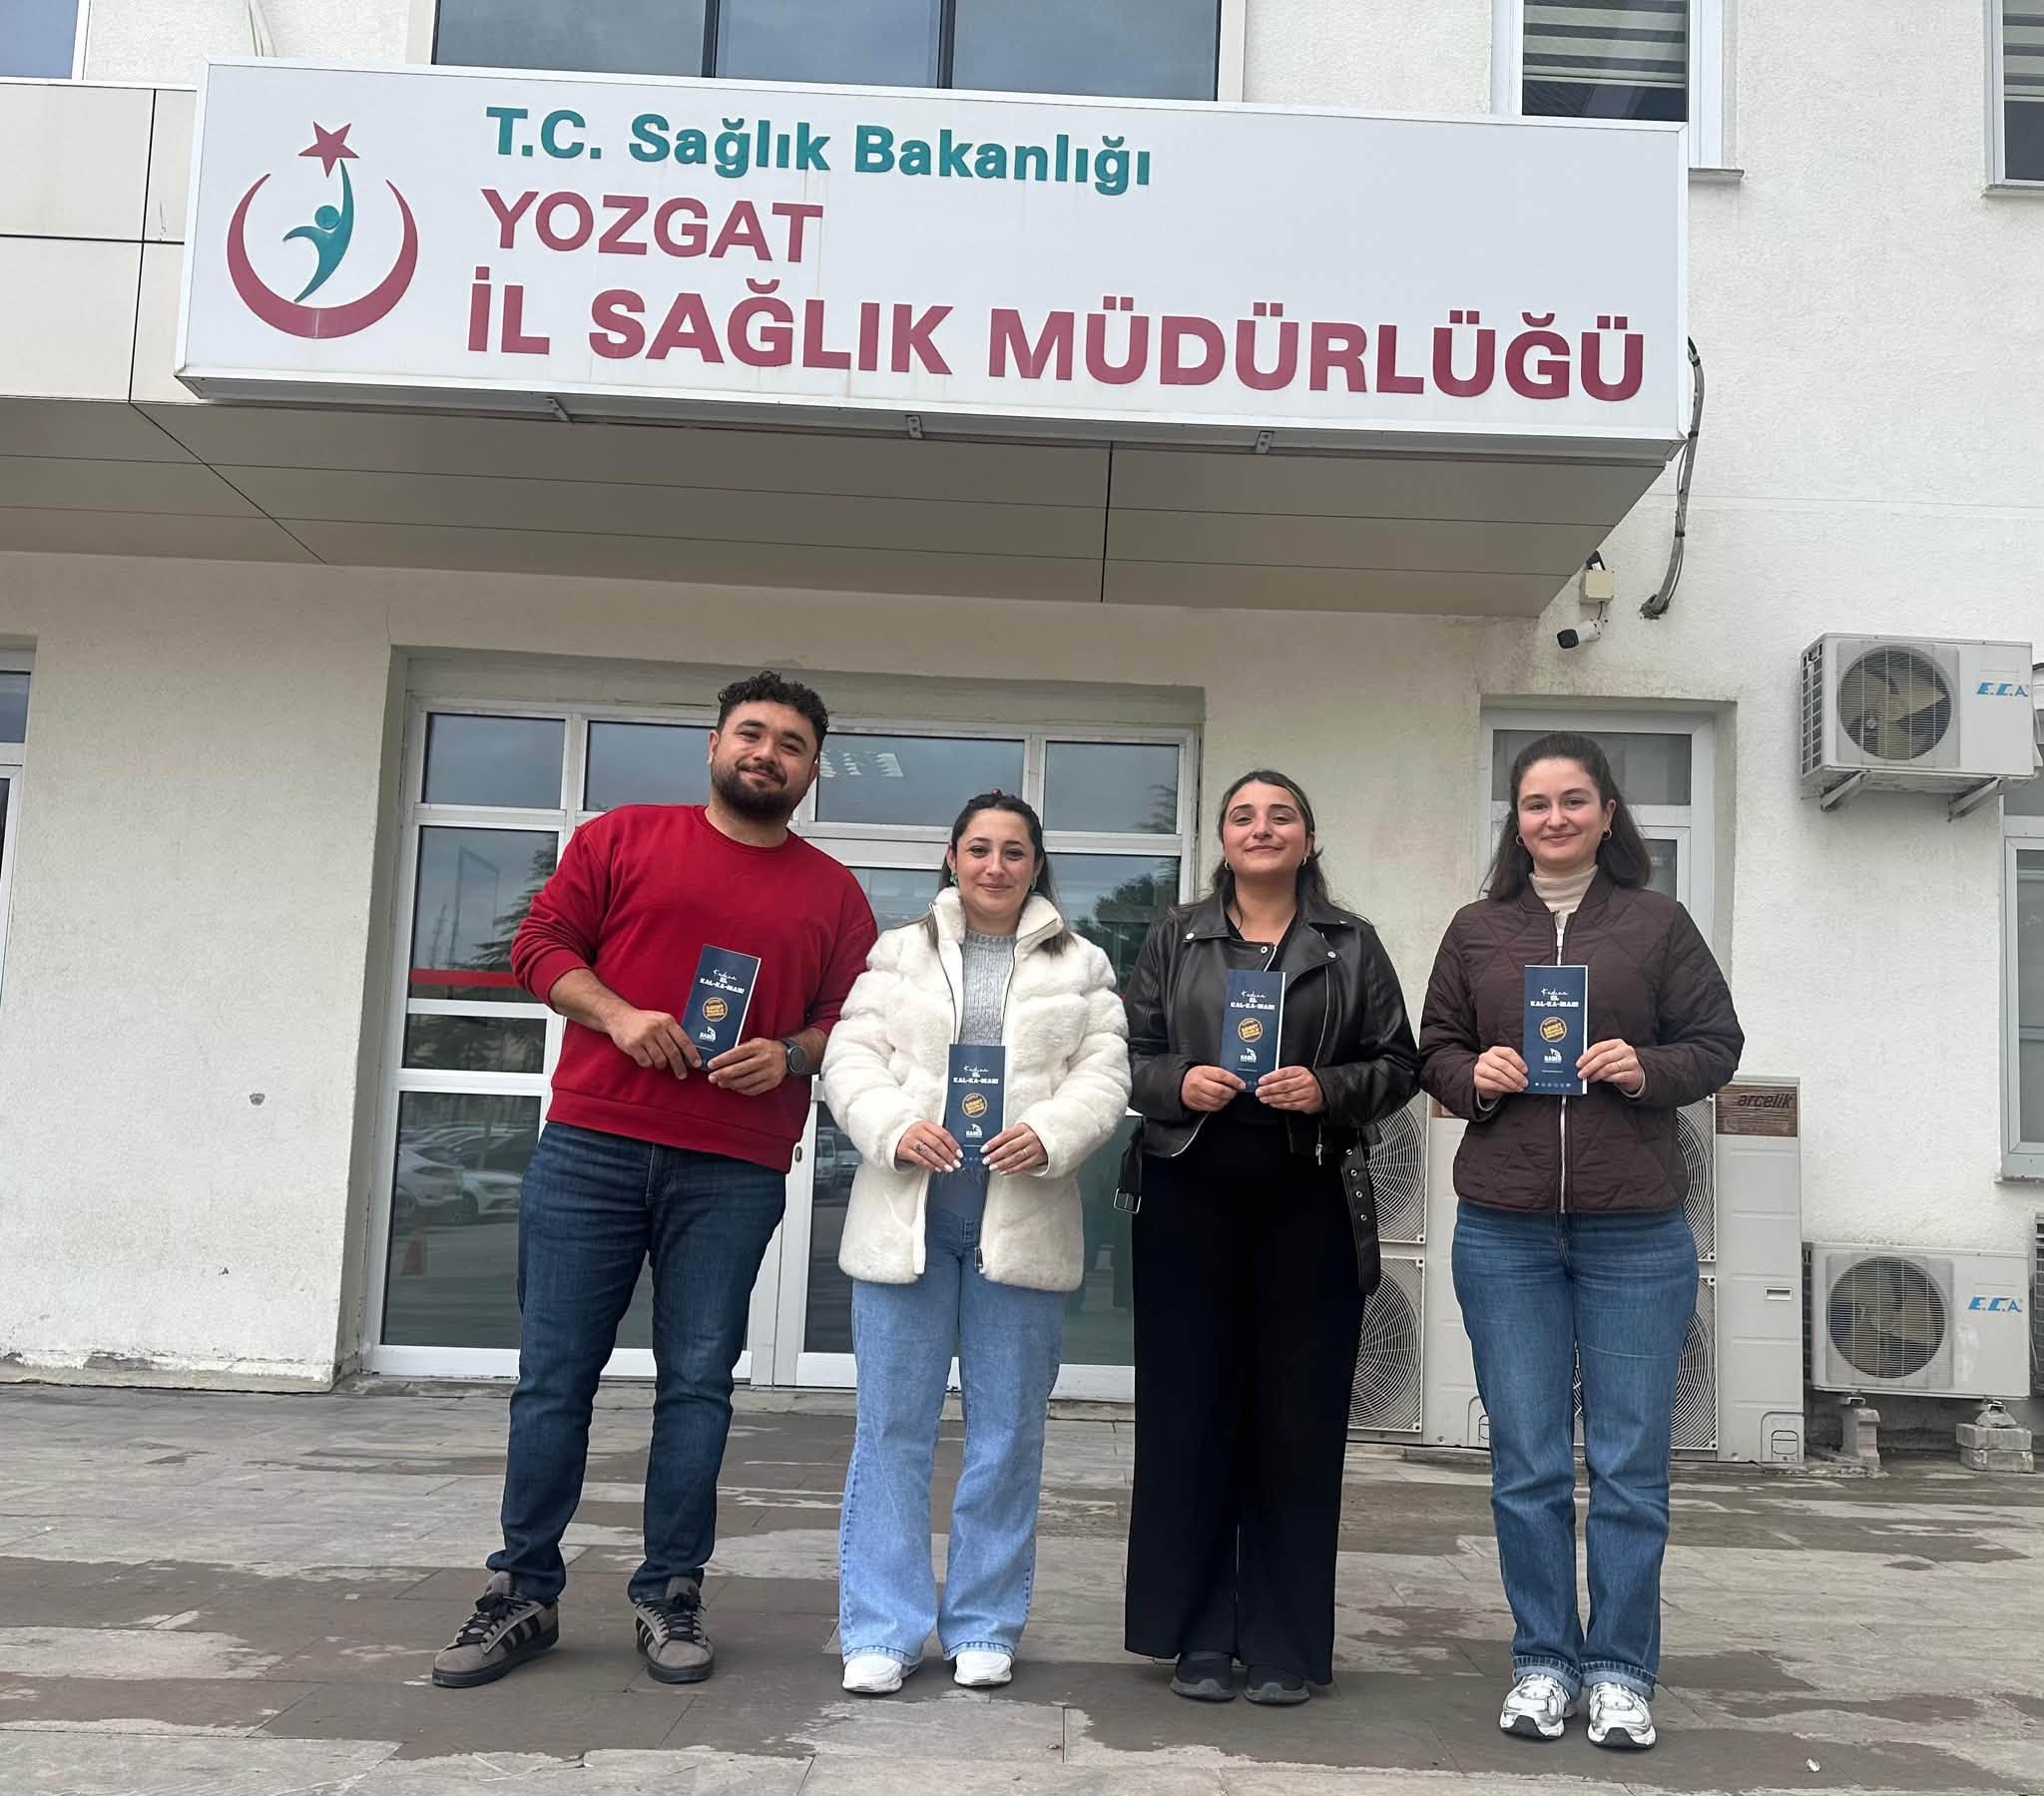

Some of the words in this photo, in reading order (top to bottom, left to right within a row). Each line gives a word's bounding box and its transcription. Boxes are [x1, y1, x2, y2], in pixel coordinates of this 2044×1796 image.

[486, 106, 601, 161] T.C.
[629, 113, 830, 179] Sağlık
[854, 124, 1151, 197] Bakanlığı
[480, 188, 824, 263] YOZGAT
[467, 265, 551, 355] İL
[588, 277, 954, 376] SAĞLIK
[987, 295, 1645, 402] MÜDÜRLÜĞÜ
